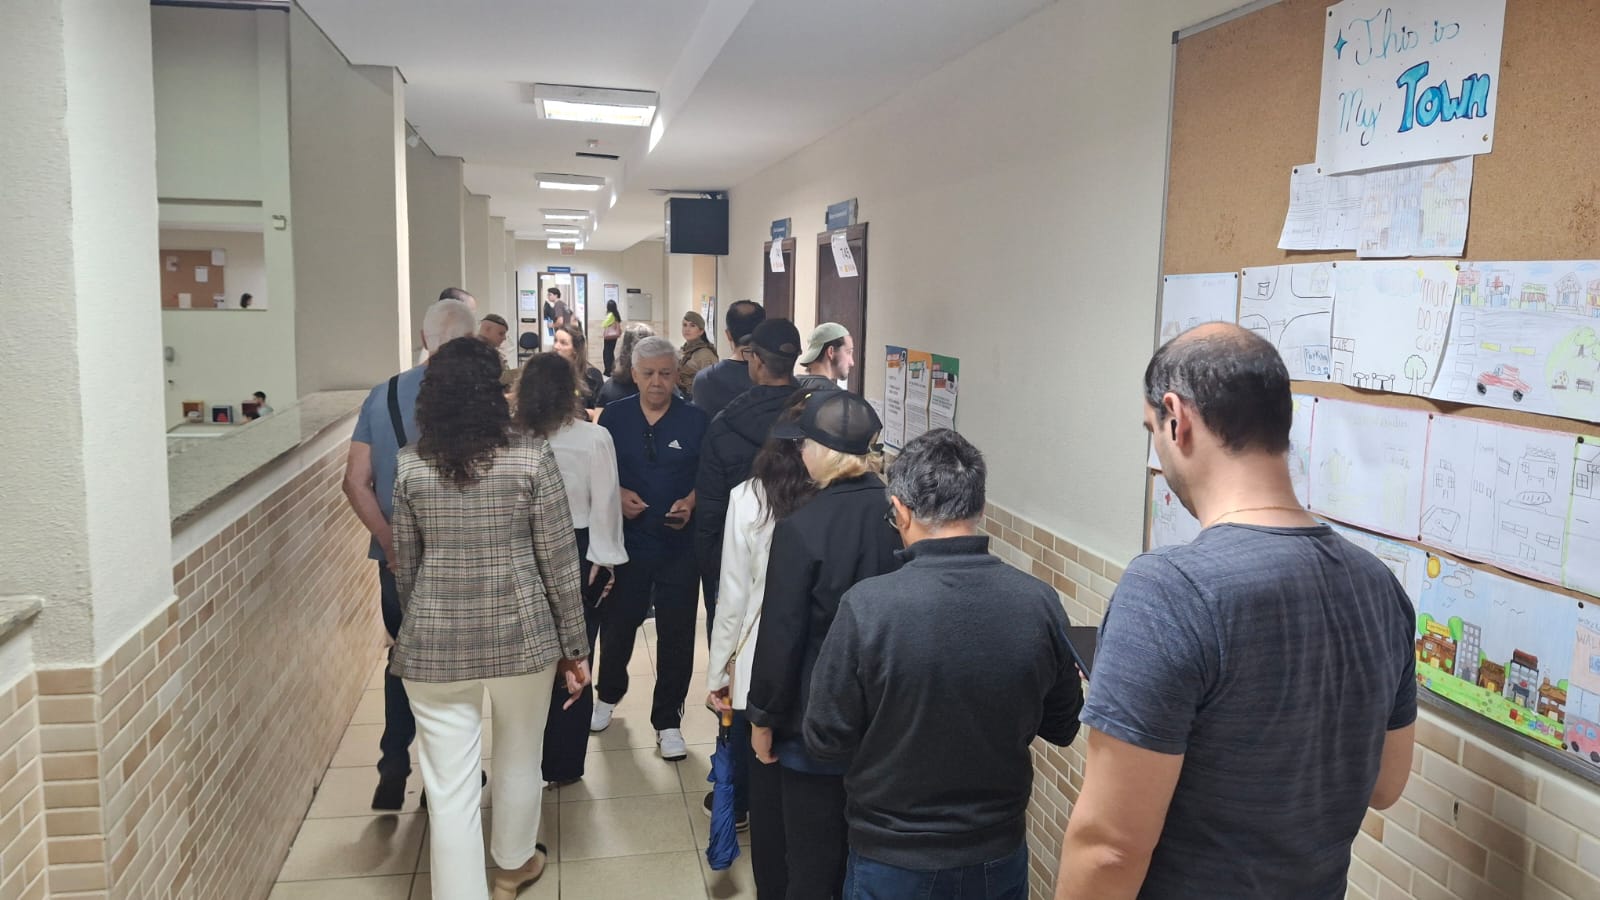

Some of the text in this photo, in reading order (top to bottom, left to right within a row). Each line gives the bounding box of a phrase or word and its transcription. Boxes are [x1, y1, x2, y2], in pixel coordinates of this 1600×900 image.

[1348, 8, 1460, 65] This is
[1339, 61, 1490, 146] My Town
